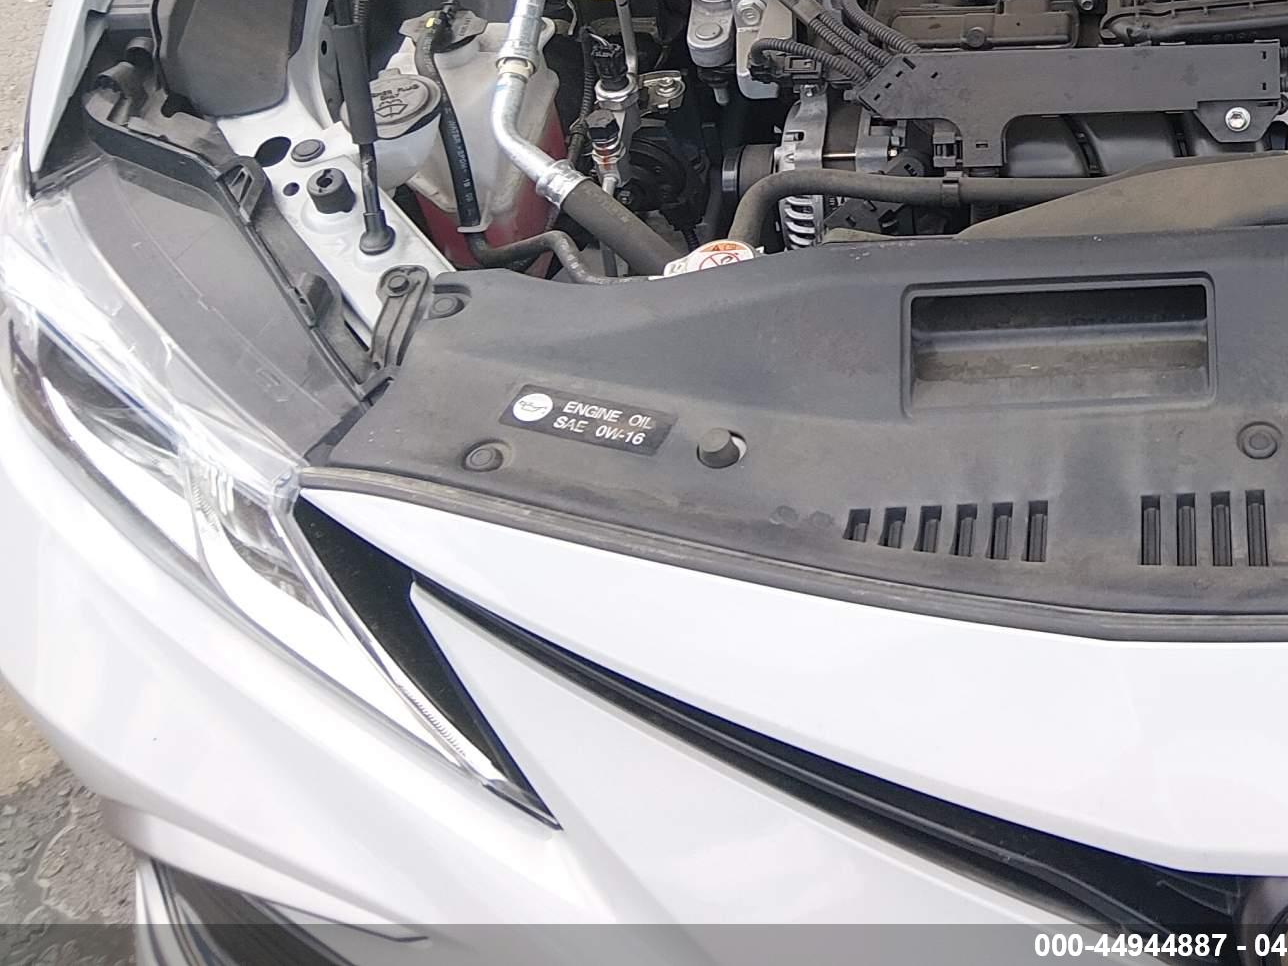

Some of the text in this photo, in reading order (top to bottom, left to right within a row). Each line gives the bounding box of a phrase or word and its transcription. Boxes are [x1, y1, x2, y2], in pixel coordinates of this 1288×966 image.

[553, 415, 646, 446] SAE 0W-16
[563, 401, 653, 430] ENGINE OIL
